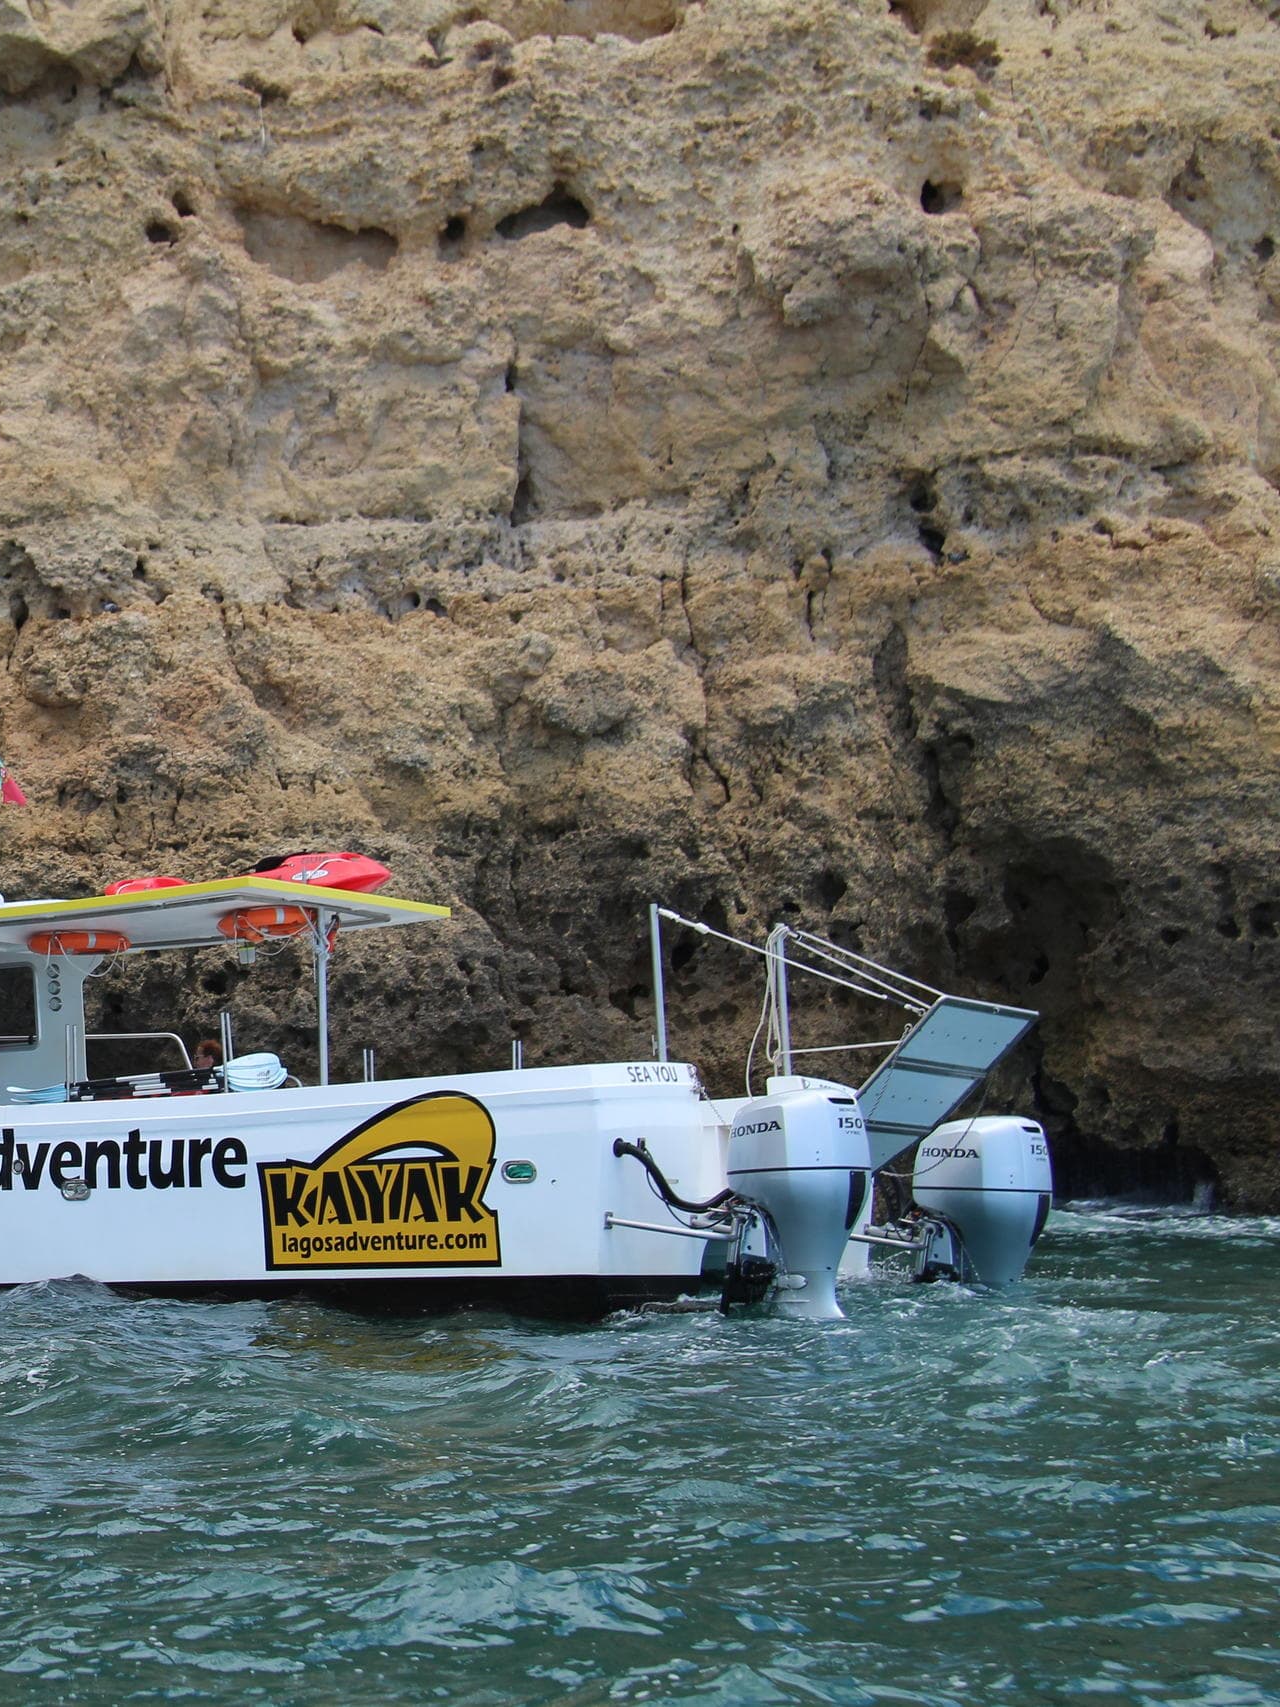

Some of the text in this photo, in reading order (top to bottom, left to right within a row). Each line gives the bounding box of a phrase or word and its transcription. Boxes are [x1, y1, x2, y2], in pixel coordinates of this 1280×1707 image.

[627, 1065, 678, 1083] SEA YOU
[730, 1120, 782, 1139] HONDA
[837, 1117, 863, 1129] 150
[921, 1147, 980, 1159] HONDA
[269, 1164, 485, 1227] KAYAK
[282, 1231, 487, 1258] lagosadventure.com
